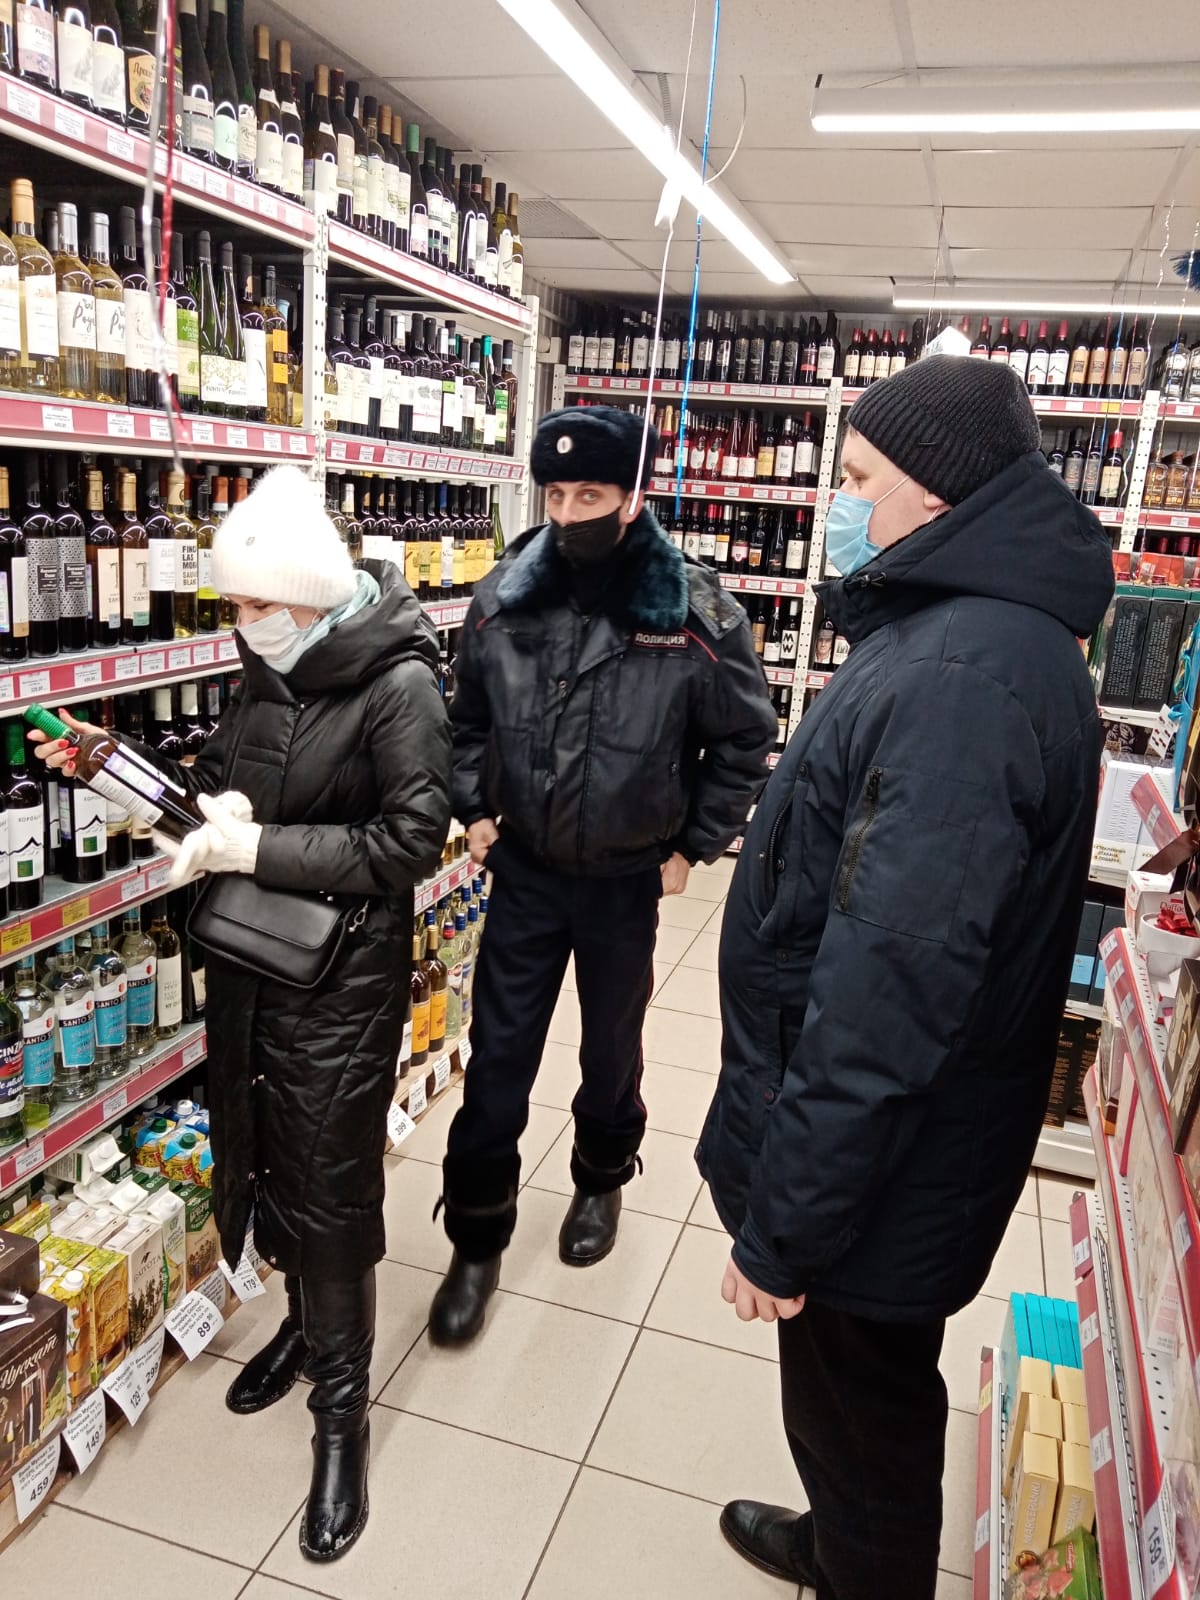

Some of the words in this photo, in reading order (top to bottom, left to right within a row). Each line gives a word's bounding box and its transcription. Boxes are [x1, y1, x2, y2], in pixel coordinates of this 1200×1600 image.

[635, 633, 685, 646] ПОЛИЦИЯ
[783, 633, 794, 642] M
[782, 644, 793, 653] W
[62, 1016, 86, 1027] SANTO
[243, 1278, 257, 1291] 179
[197, 1321, 211, 1338] 89
[85, 1431, 100, 1453] 149
[29, 1476, 49, 1502] 459
[1148, 1526, 1162, 1565] 159
